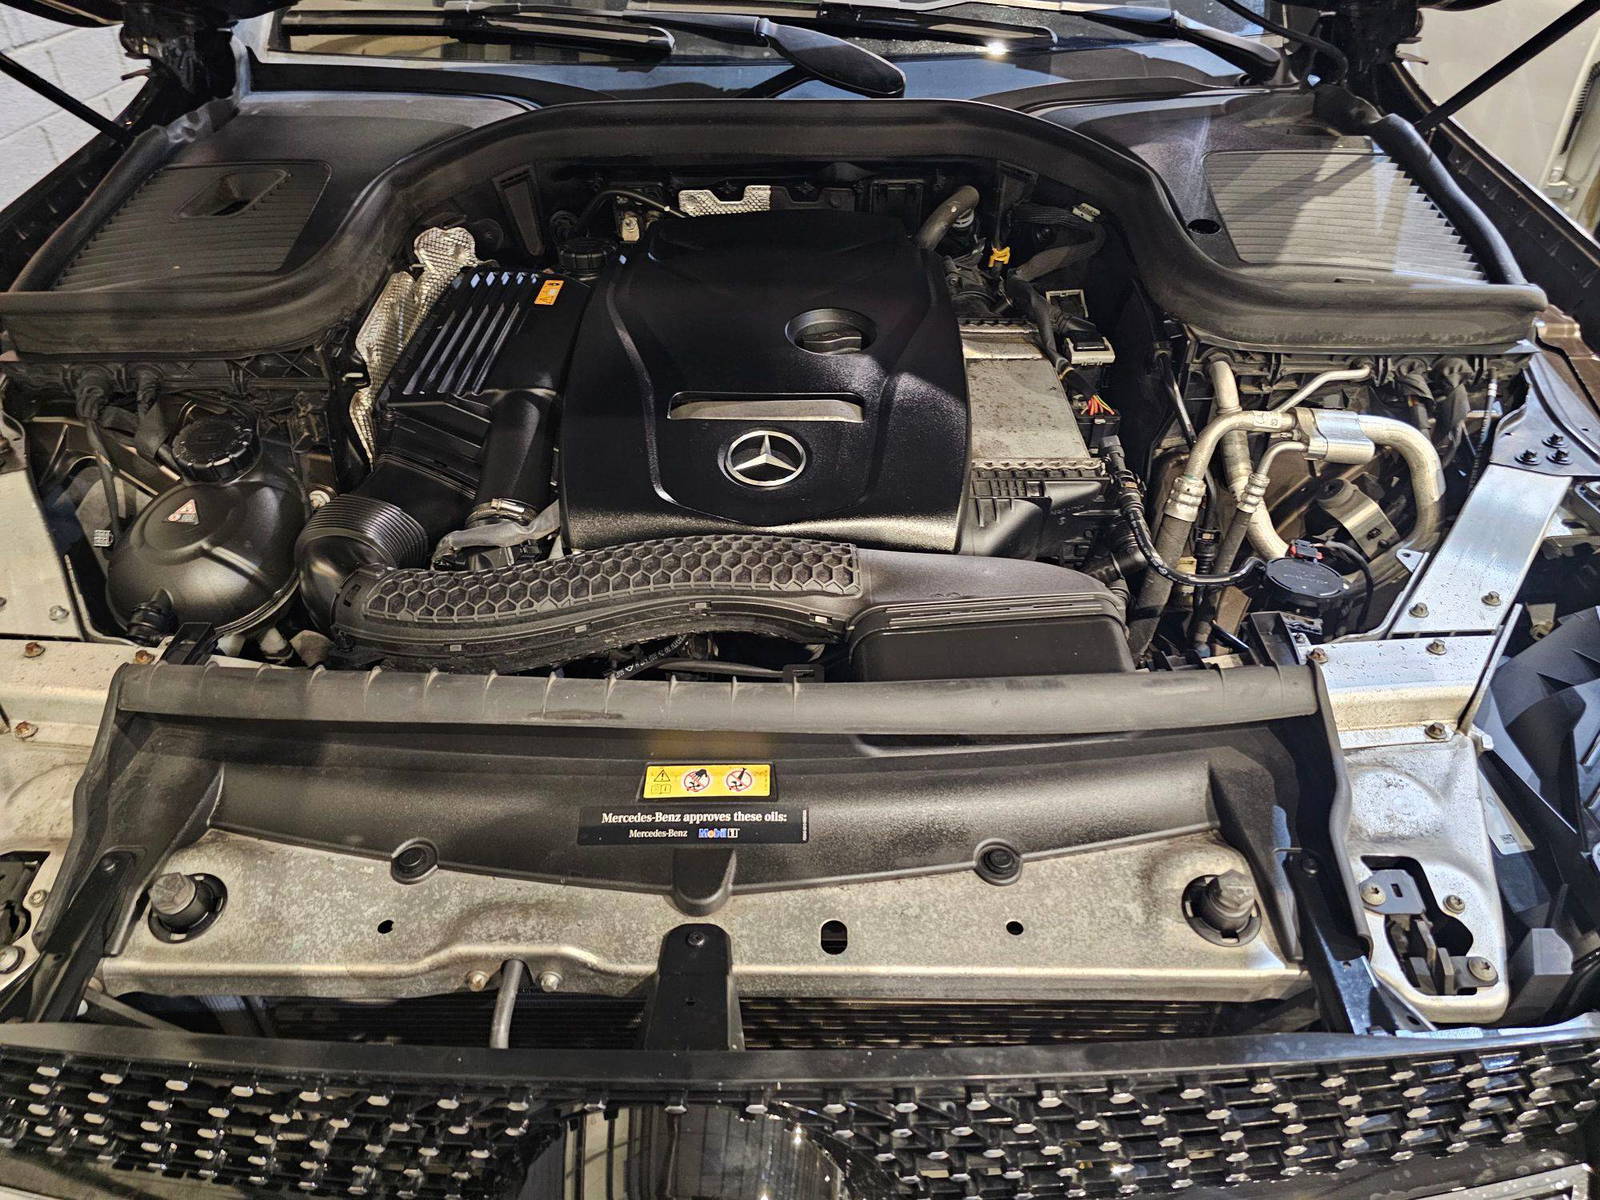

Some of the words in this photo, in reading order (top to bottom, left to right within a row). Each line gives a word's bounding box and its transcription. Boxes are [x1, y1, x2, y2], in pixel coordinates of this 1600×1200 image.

[601, 812, 681, 823] Mercedes-Benz
[683, 813, 731, 824] approves
[733, 811, 762, 822] these
[764, 811, 787, 822] oils:
[629, 829, 688, 838] Mercedes-Benz
[698, 828, 727, 838] Mobil
